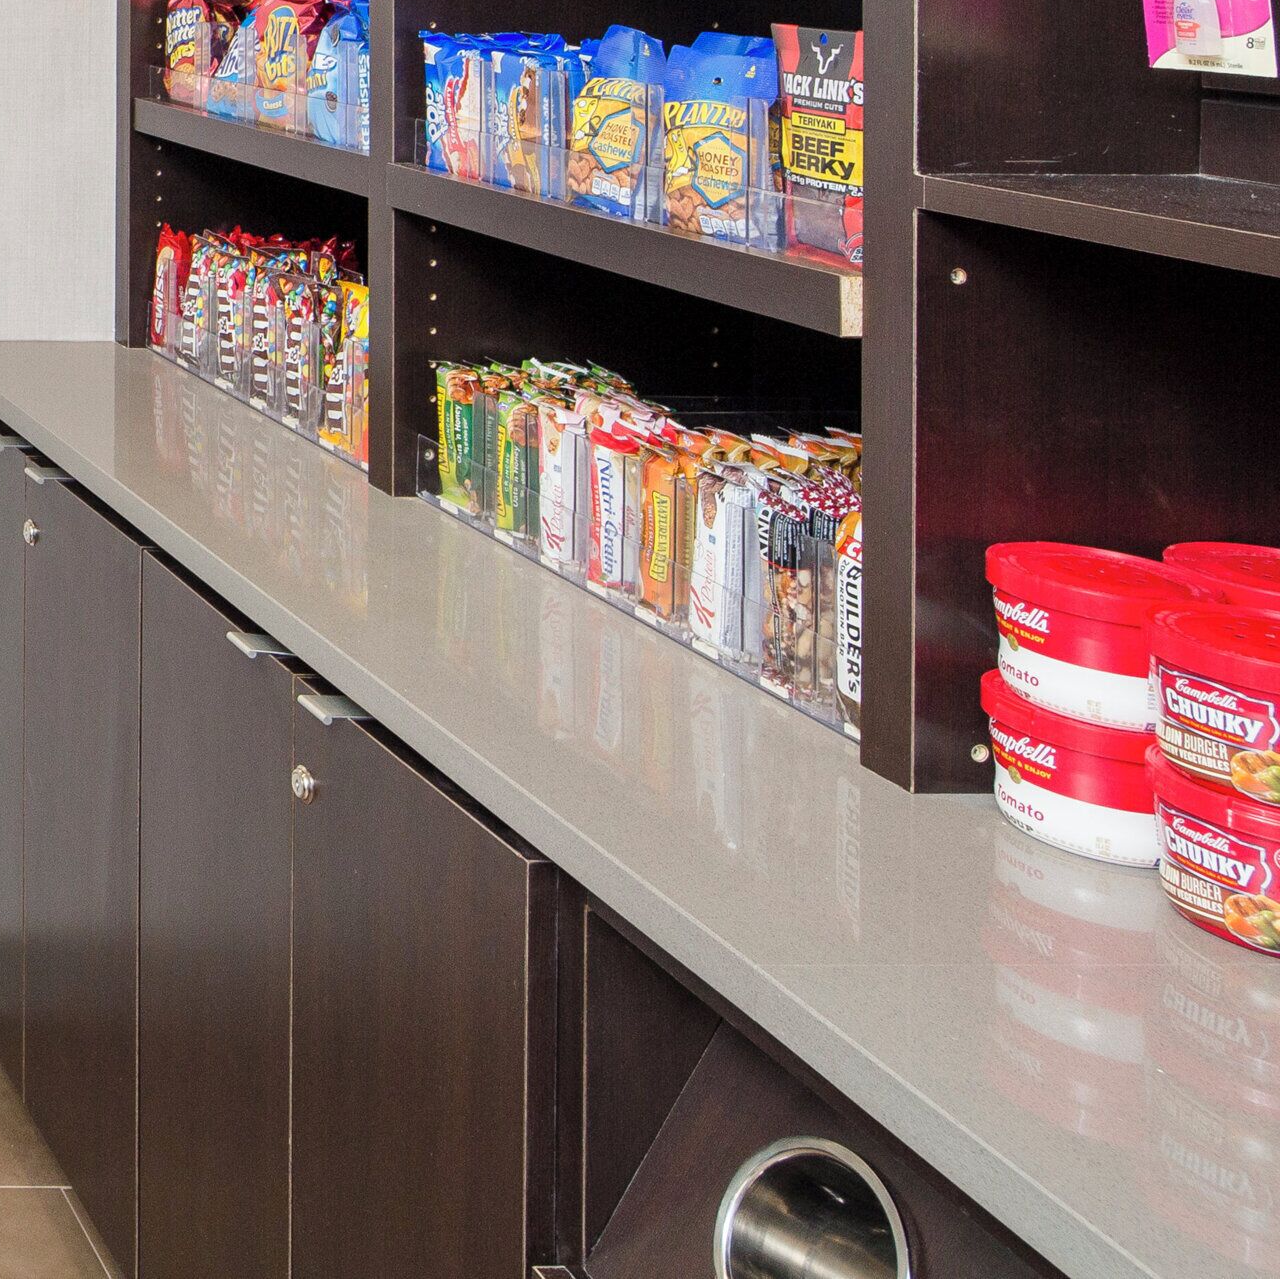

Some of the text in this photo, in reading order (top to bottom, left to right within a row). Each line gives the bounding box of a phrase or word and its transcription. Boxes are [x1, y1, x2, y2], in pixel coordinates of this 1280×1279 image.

[1175, 4, 1194, 15] Clear
[1246, 37, 1255, 50] 8
[263, 99, 284, 110] Cheese
[794, 98, 844, 112] PREMIUM CUTS
[813, 78, 864, 105] LINK'S
[664, 102, 747, 129] PLANTERS
[798, 115, 836, 131] TERIYAKI
[698, 151, 739, 165] HONEY
[792, 133, 844, 158] BEEF
[700, 162, 739, 177] ROASTED
[806, 177, 846, 193] PROTEIN
[455, 404, 463, 432] Honey
[551, 482, 565, 536] Protein
[701, 549, 715, 603] Protein
[1020, 629, 1046, 644] ENJOY
[1175, 677, 1239, 711] Campbell's
[1165, 687, 1264, 744] CHUNKY
[1184, 731, 1229, 761] BURGER
[1024, 763, 1053, 780] ENJOY
[1179, 748, 1232, 773] VEGETABLES
[997, 782, 1045, 822] Tomato
[1172, 815, 1232, 855] Campbell's
[1164, 825, 1256, 887] CHUNKY
[1181, 871, 1223, 902] BURGER
[1177, 887, 1225, 915] VEGETABLES
